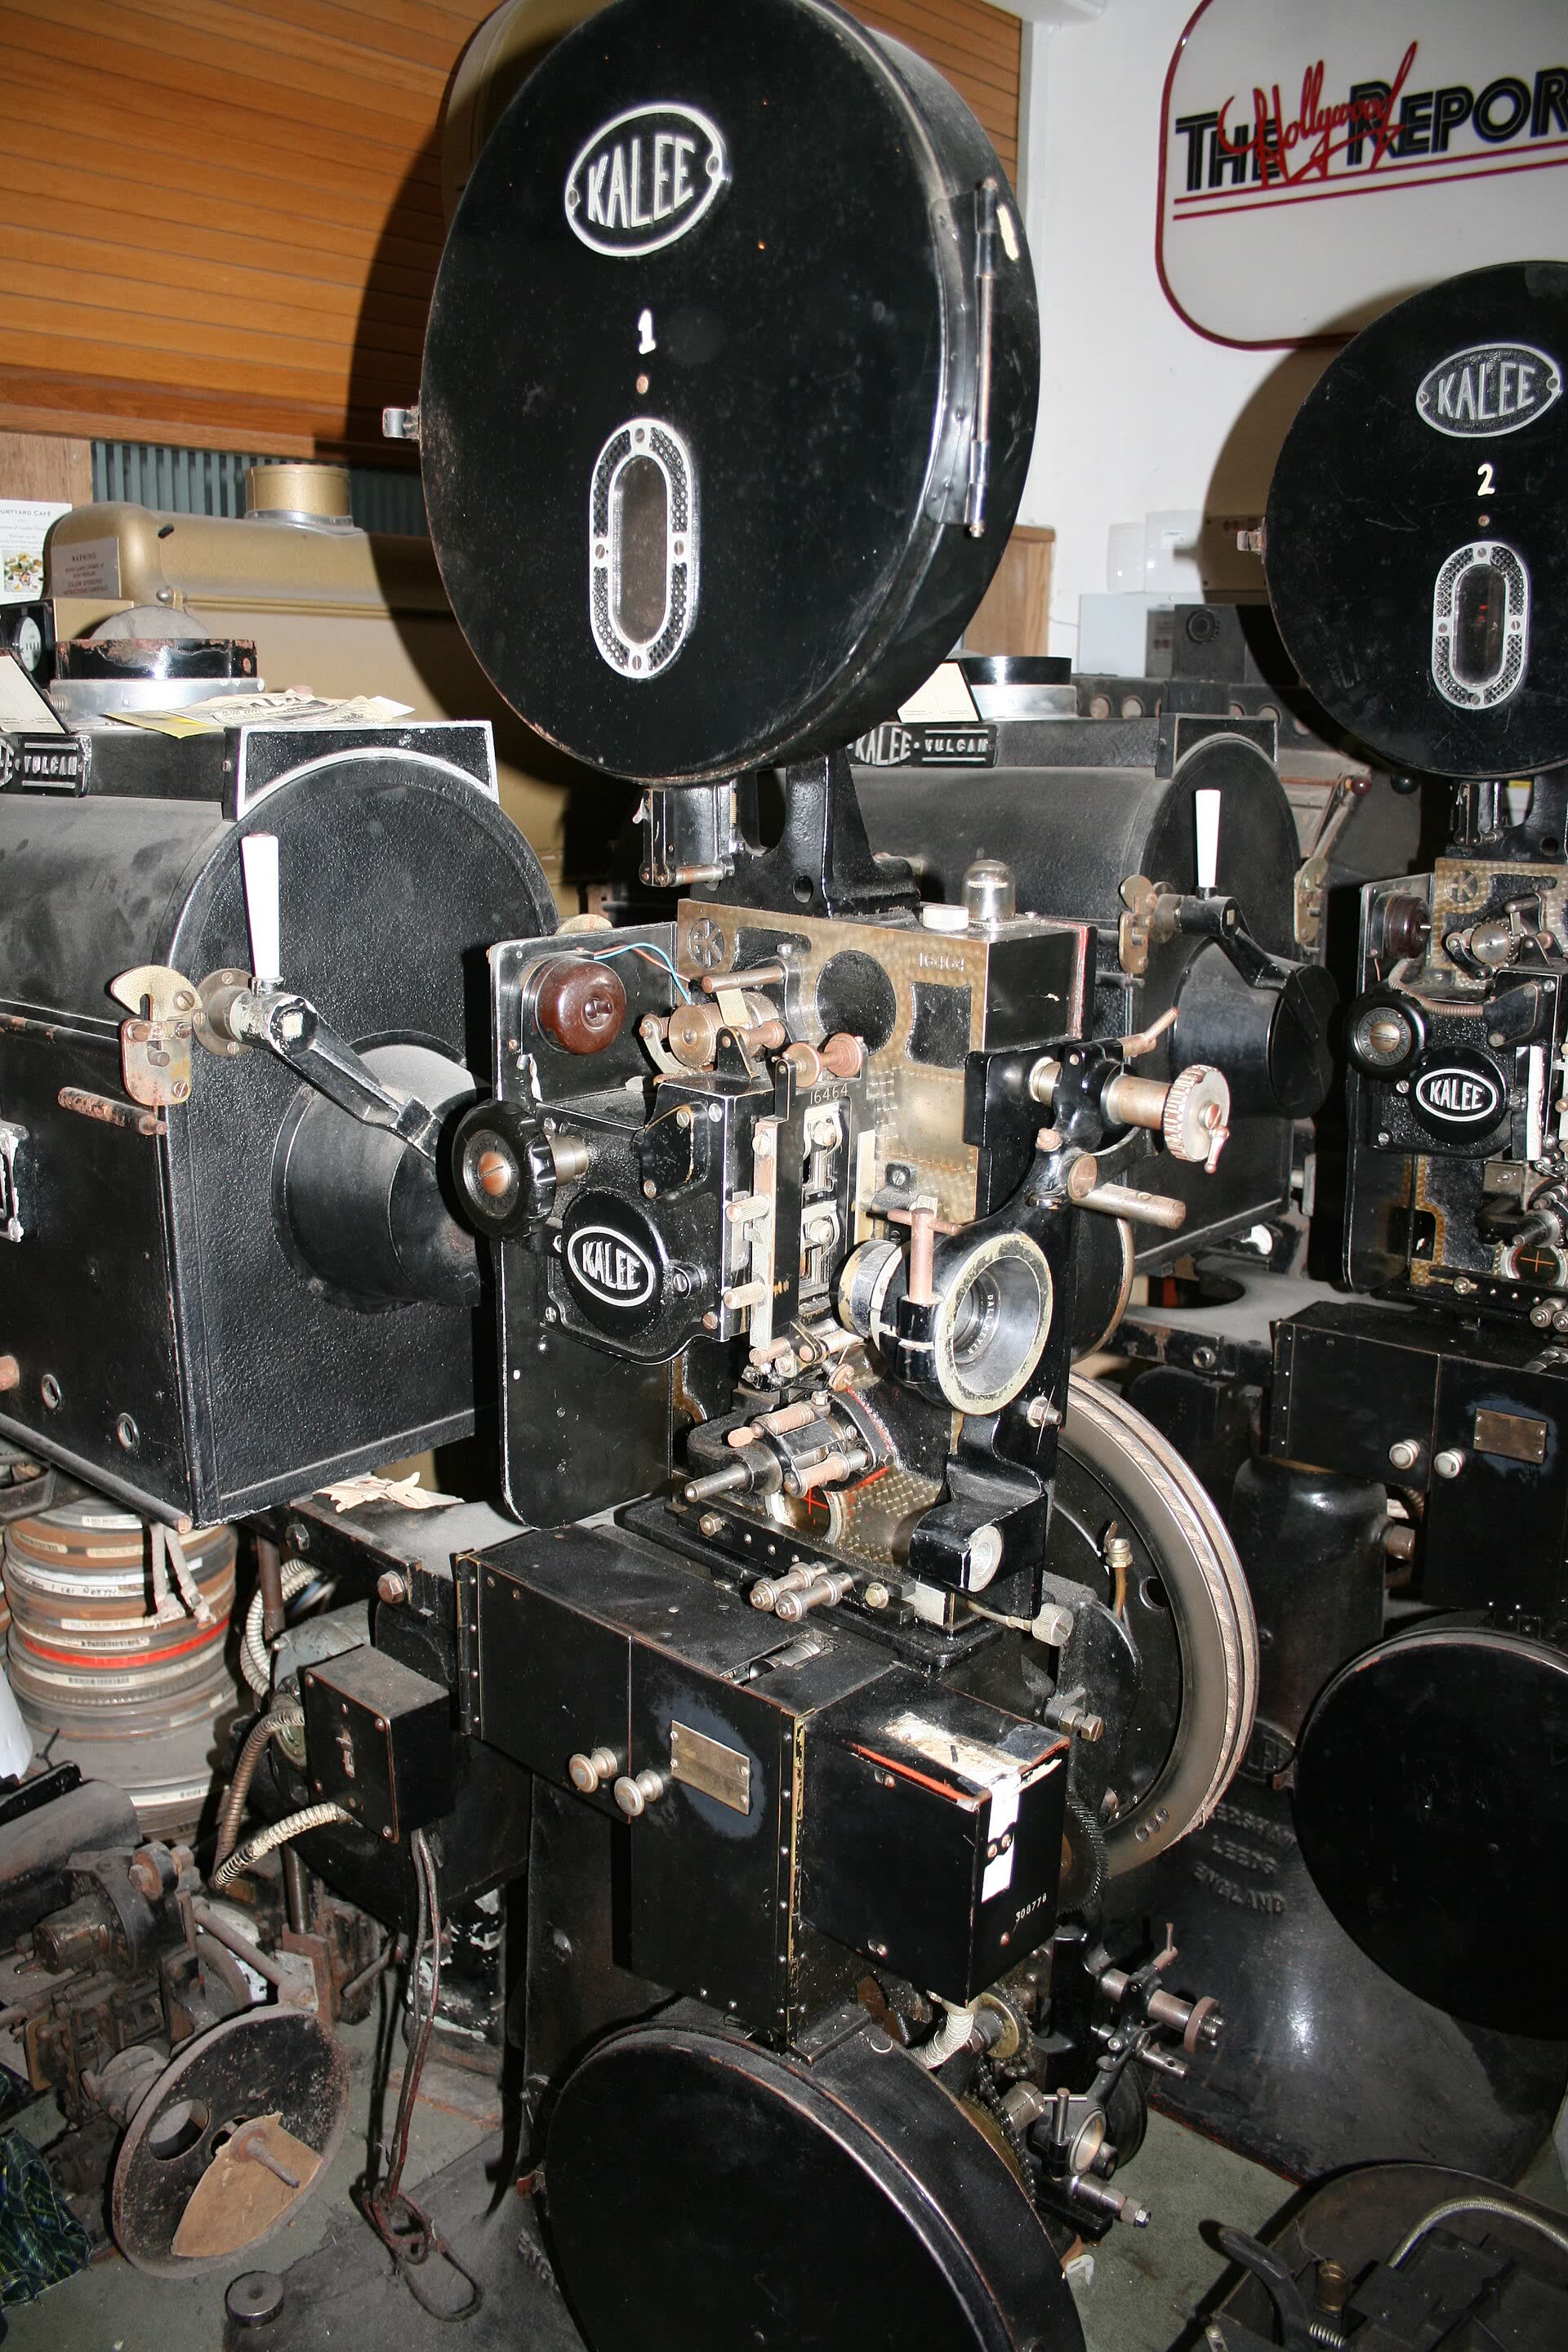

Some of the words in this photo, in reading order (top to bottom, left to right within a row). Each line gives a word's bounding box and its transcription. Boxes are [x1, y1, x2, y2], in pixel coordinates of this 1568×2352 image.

[1217, 41, 1418, 187] Hollywood
[1175, 111, 1281, 191] THE
[588, 135, 694, 229] KALEE
[638, 308, 657, 354] 1
[1437, 362, 1535, 421] KALEE
[1477, 463, 1495, 497] 2
[24, 755, 78, 776] VULCAN
[855, 727, 912, 767] KALEE
[924, 738, 989, 753] VULCAN
[918, 952, 965, 973] 16464
[810, 1084, 849, 1104] 16464
[1430, 1078, 1484, 1111] KALEE
[582, 1241, 640, 1290] KALEE
[968, 1294, 995, 1355] DALLMEYER
[1211, 1834, 1280, 1876] LEEDS
[1192, 1860, 1286, 1915] ENGLAND
